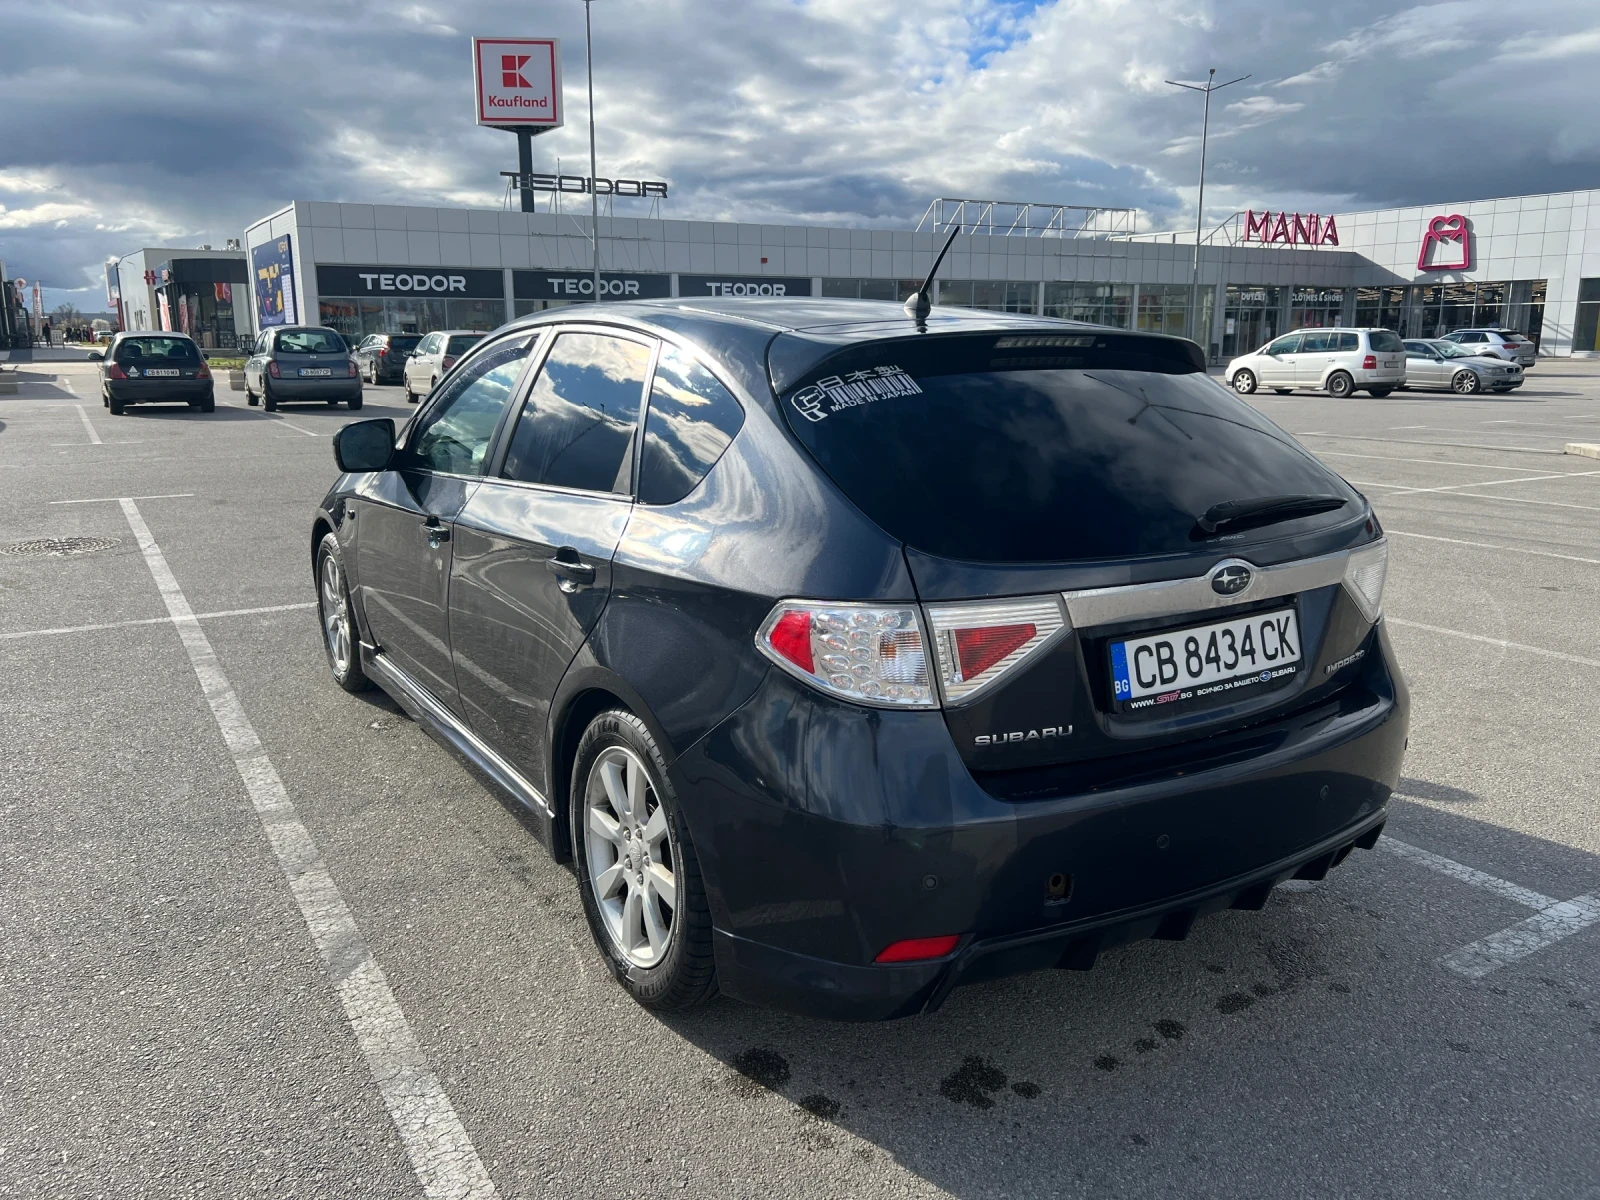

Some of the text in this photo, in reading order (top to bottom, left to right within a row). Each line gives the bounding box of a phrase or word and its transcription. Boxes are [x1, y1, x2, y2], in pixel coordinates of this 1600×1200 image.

[488, 95, 547, 108] Kaufland
[500, 171, 668, 198] TEODOR
[1243, 209, 1339, 246] MANIA
[359, 273, 467, 292] TEODOR
[547, 278, 640, 296] TEODOR
[706, 282, 787, 297] TEODOR
[1241, 292, 1266, 301] OUTLET
[1292, 293, 1318, 302] CLOTHES
[1323, 295, 1344, 303] SHOES
[830, 387, 918, 412] MADE IN JAPAN
[1133, 616, 1296, 690] CB 8434 CK
[1233, 676, 1260, 688] ВАШЕТО
[1271, 666, 1297, 679] SUBARU
[1114, 679, 1130, 695] BG
[974, 725, 1074, 746] SUBARU
